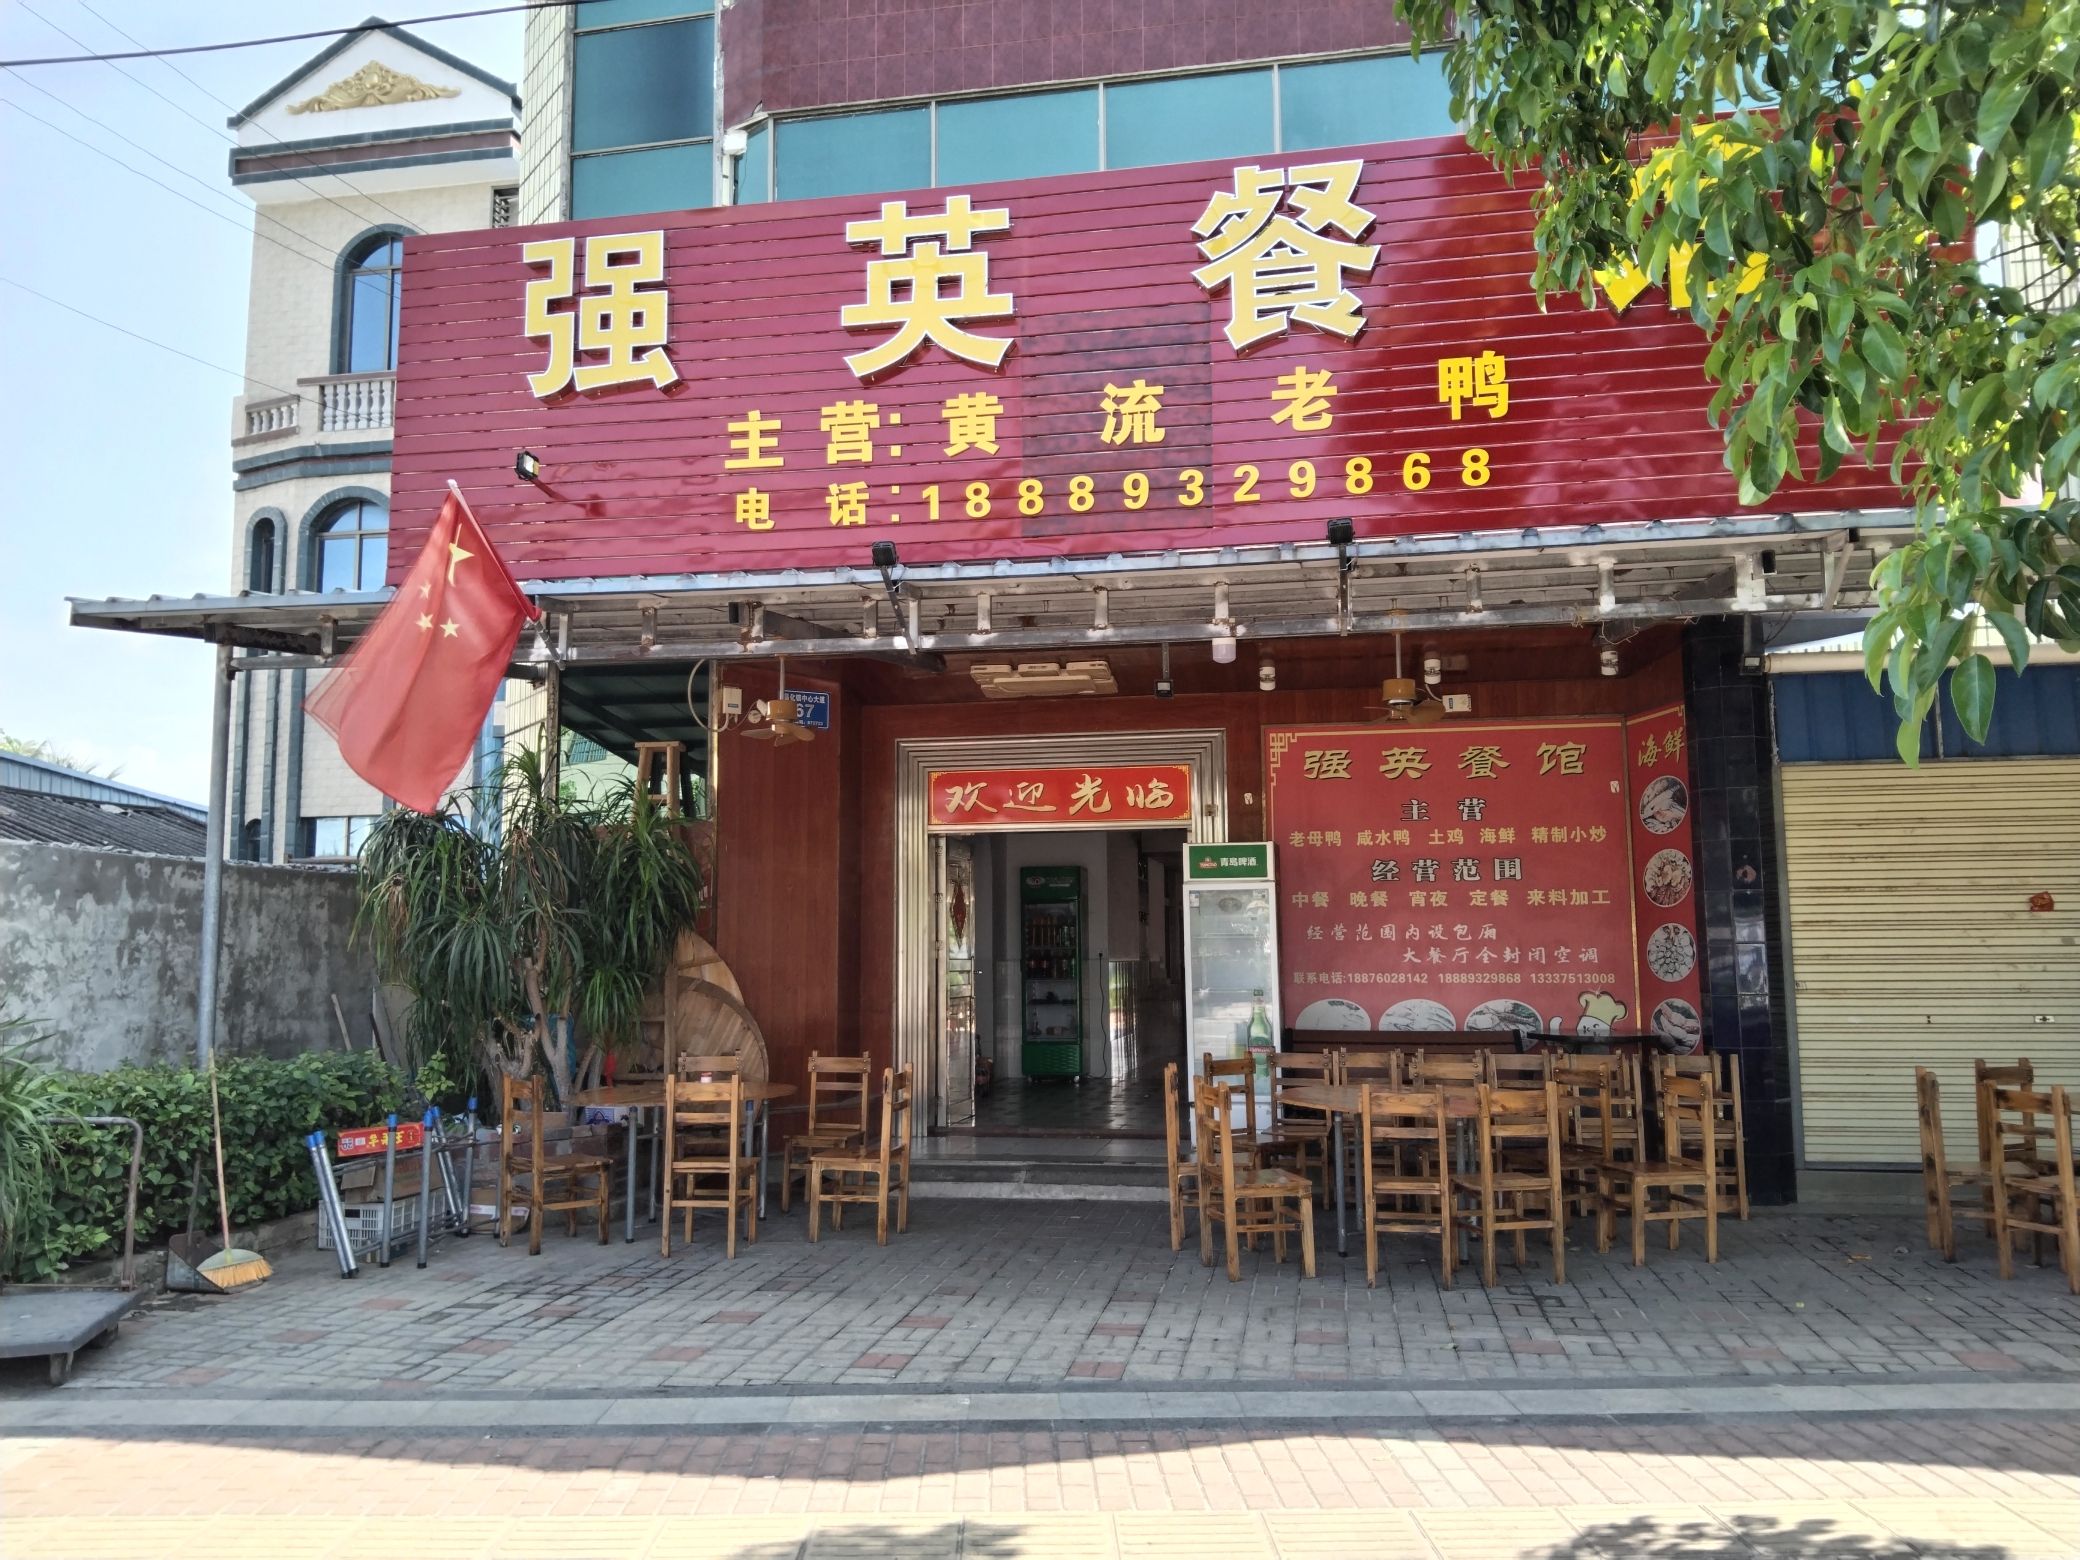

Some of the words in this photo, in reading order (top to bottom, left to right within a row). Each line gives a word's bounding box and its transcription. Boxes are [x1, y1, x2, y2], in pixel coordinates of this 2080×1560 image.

[725, 351, 1510, 470] 主营:黄流老鸭
[735, 448, 1491, 531] 电话:18889329868
[1638, 727, 1685, 768] 海鲜
[1304, 742, 1587, 780] 强英餐馆
[945, 774, 1175, 815] 欢迎光临
[1400, 798, 1487, 821] 主营
[1289, 830, 1342, 847] 老母鸭
[1356, 829, 1410, 846] 咸水鸭
[1428, 828, 1464, 845] 土鸡
[1480, 827, 1516, 844] 海鲜
[1531, 825, 1607, 843] 精制小炒
[1371, 857, 1522, 882] 经营范围
[1291, 891, 1330, 908] 中餐
[1349, 890, 1389, 907] 晚餐
[1409, 890, 1448, 907] 宵夜
[1469, 889, 1510, 906] 定餐
[1527, 888, 1611, 906] 来料加工
[1306, 922, 1497, 942] 经营范围内设包厢
[1402, 946, 1599, 965] 大餐厅全封闭空调
[1438, 972, 1521, 984] 18889329868
[1530, 972, 1616, 984] 13337513008
